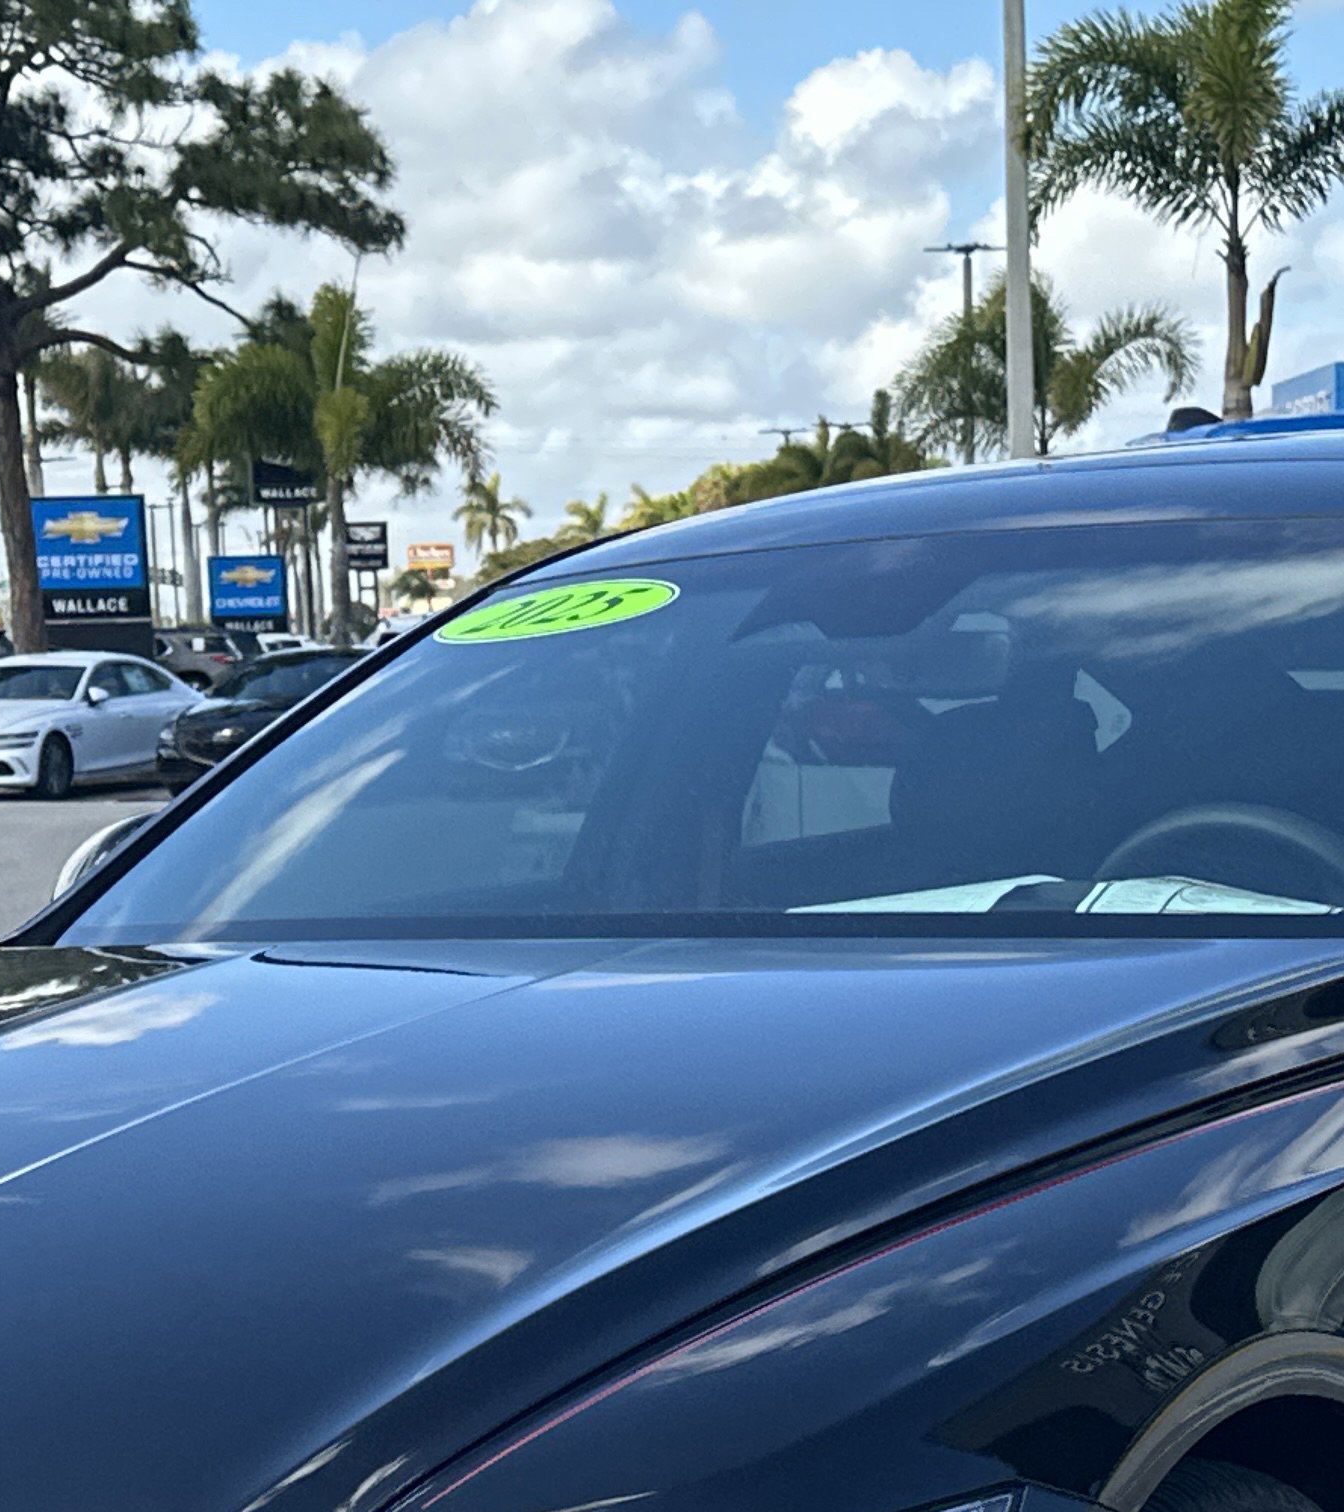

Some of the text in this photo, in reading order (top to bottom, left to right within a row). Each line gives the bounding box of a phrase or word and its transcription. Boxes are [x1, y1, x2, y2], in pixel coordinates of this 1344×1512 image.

[259, 486, 317, 499] WALLACE
[36, 553, 139, 568] CERTIFIED
[41, 566, 134, 579] PRE-OWNED
[51, 597, 128, 613] WALLACE
[458, 587, 654, 635] 2025
